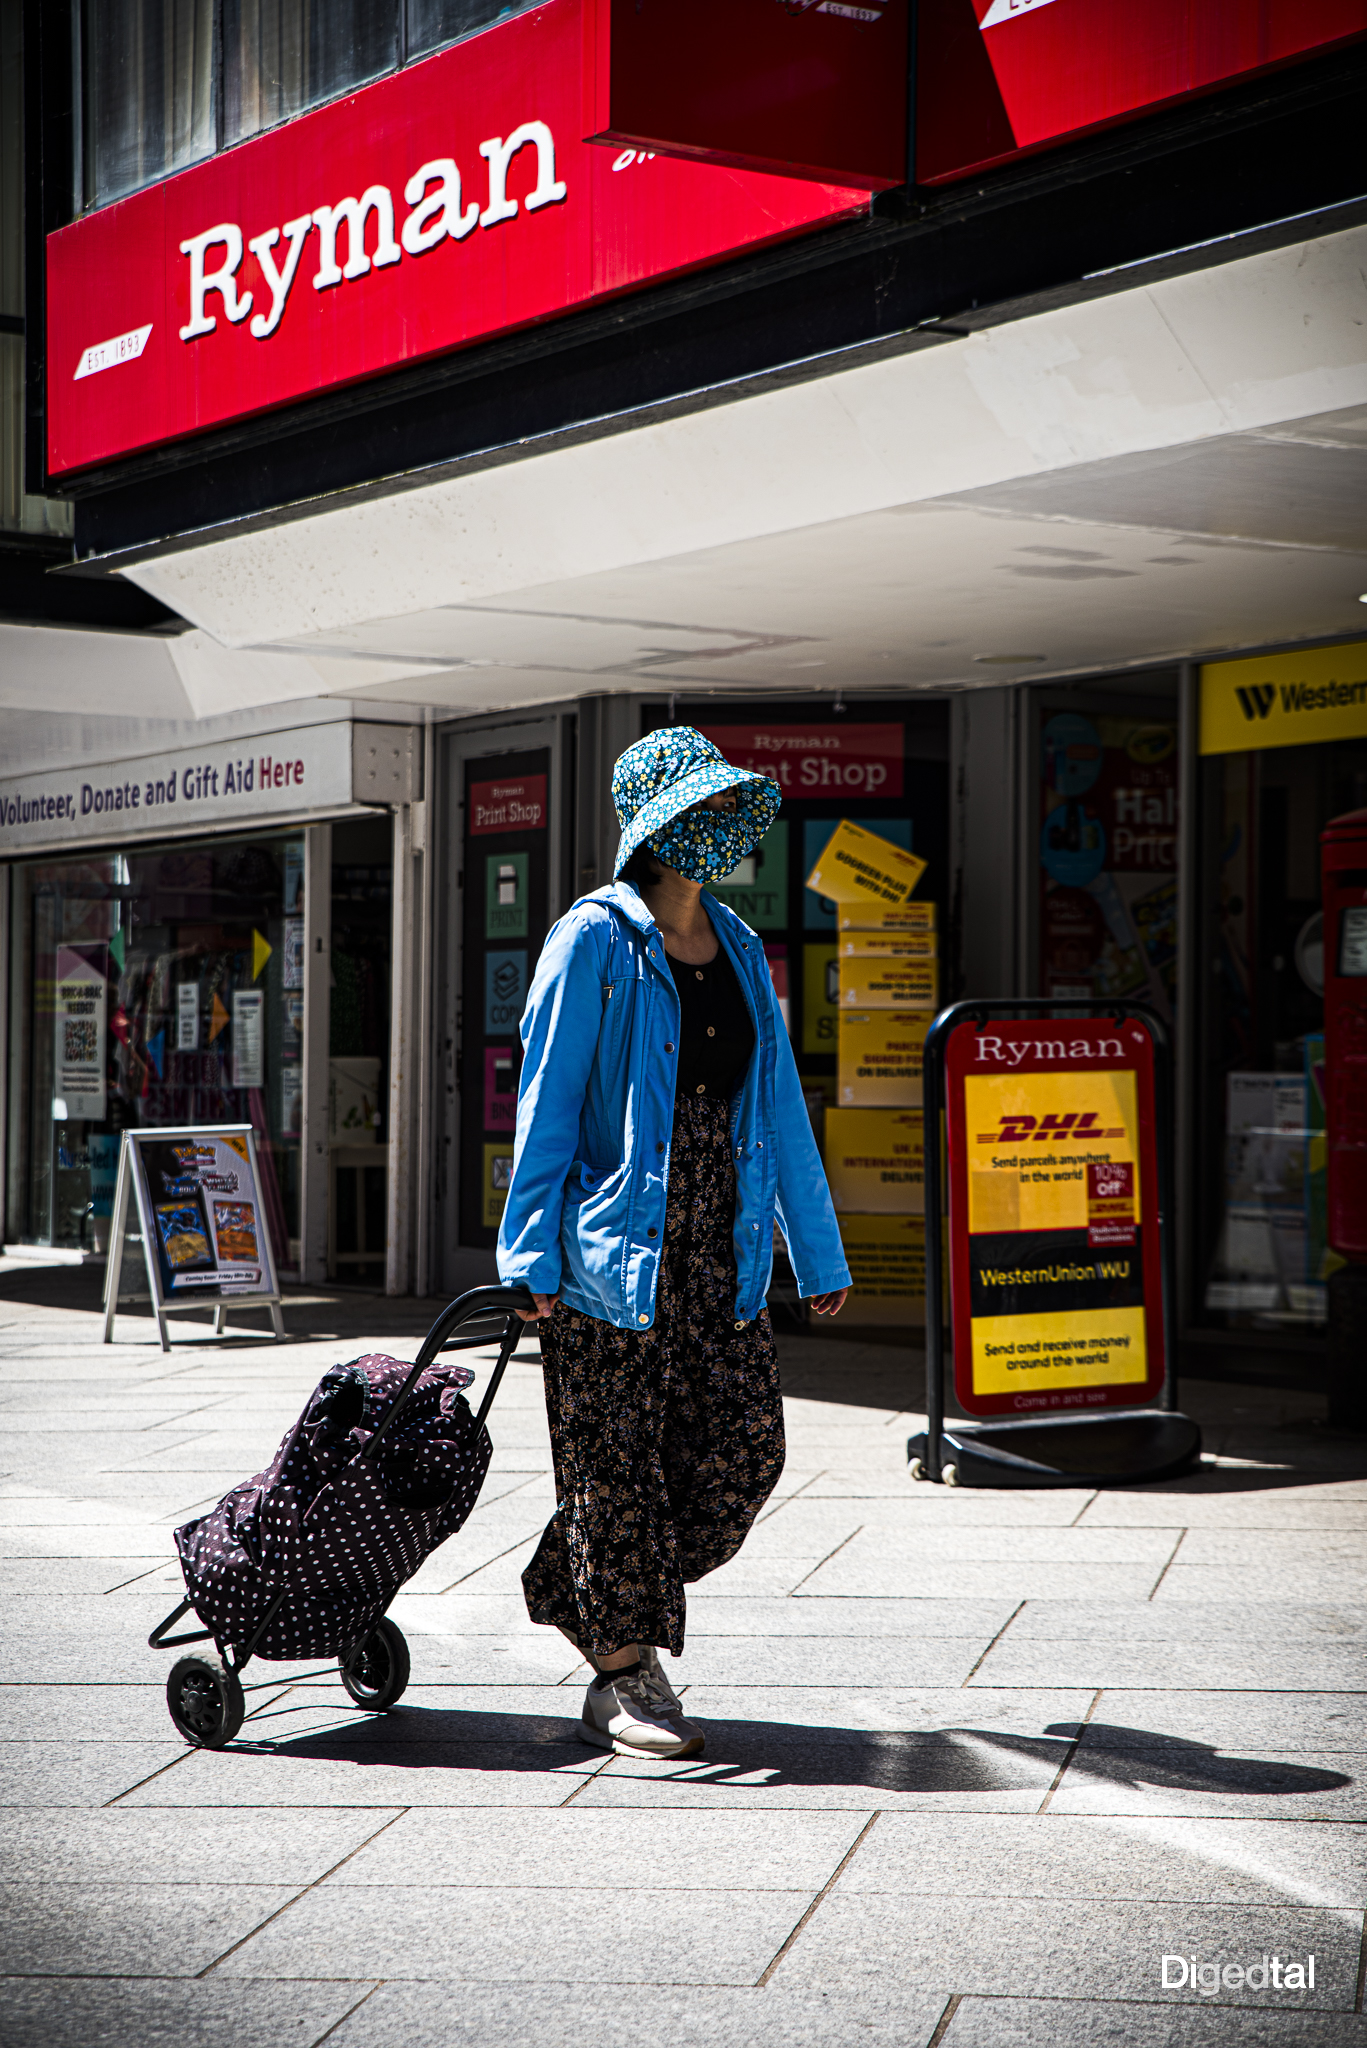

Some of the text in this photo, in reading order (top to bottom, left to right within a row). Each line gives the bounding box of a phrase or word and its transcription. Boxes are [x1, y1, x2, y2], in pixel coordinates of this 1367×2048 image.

[179, 120, 567, 341] Ryman
[88, 334, 141, 370] EST. 1893
[1280, 679, 1367, 713] Western
[754, 734, 841, 751] Ryman
[799, 756, 888, 792] Shop
[0, 756, 306, 828] Volunteer, Donate and Gift Aid Here
[475, 801, 542, 827] Print Shop
[1113, 787, 1176, 825] Hal
[1112, 826, 1176, 866] Pric
[713, 891, 778, 916] INT
[490, 907, 524, 929] PRINT
[886, 1042, 924, 1051] PARCE
[974, 1036, 1126, 1066] Ryman
[996, 1112, 1106, 1143] DHL
[843, 1156, 924, 1169] INTERNATION
[991, 1152, 1111, 1169] Send parcels anywhere
[1094, 1164, 1128, 1181] 10%
[881, 1171, 924, 1183] DELIVE
[1020, 1169, 1083, 1183] in the world
[984, 1334, 1131, 1357] Send and receive money
[1006, 1351, 1109, 1371] around the world
[1014, 1392, 1107, 1409] Come in and see
